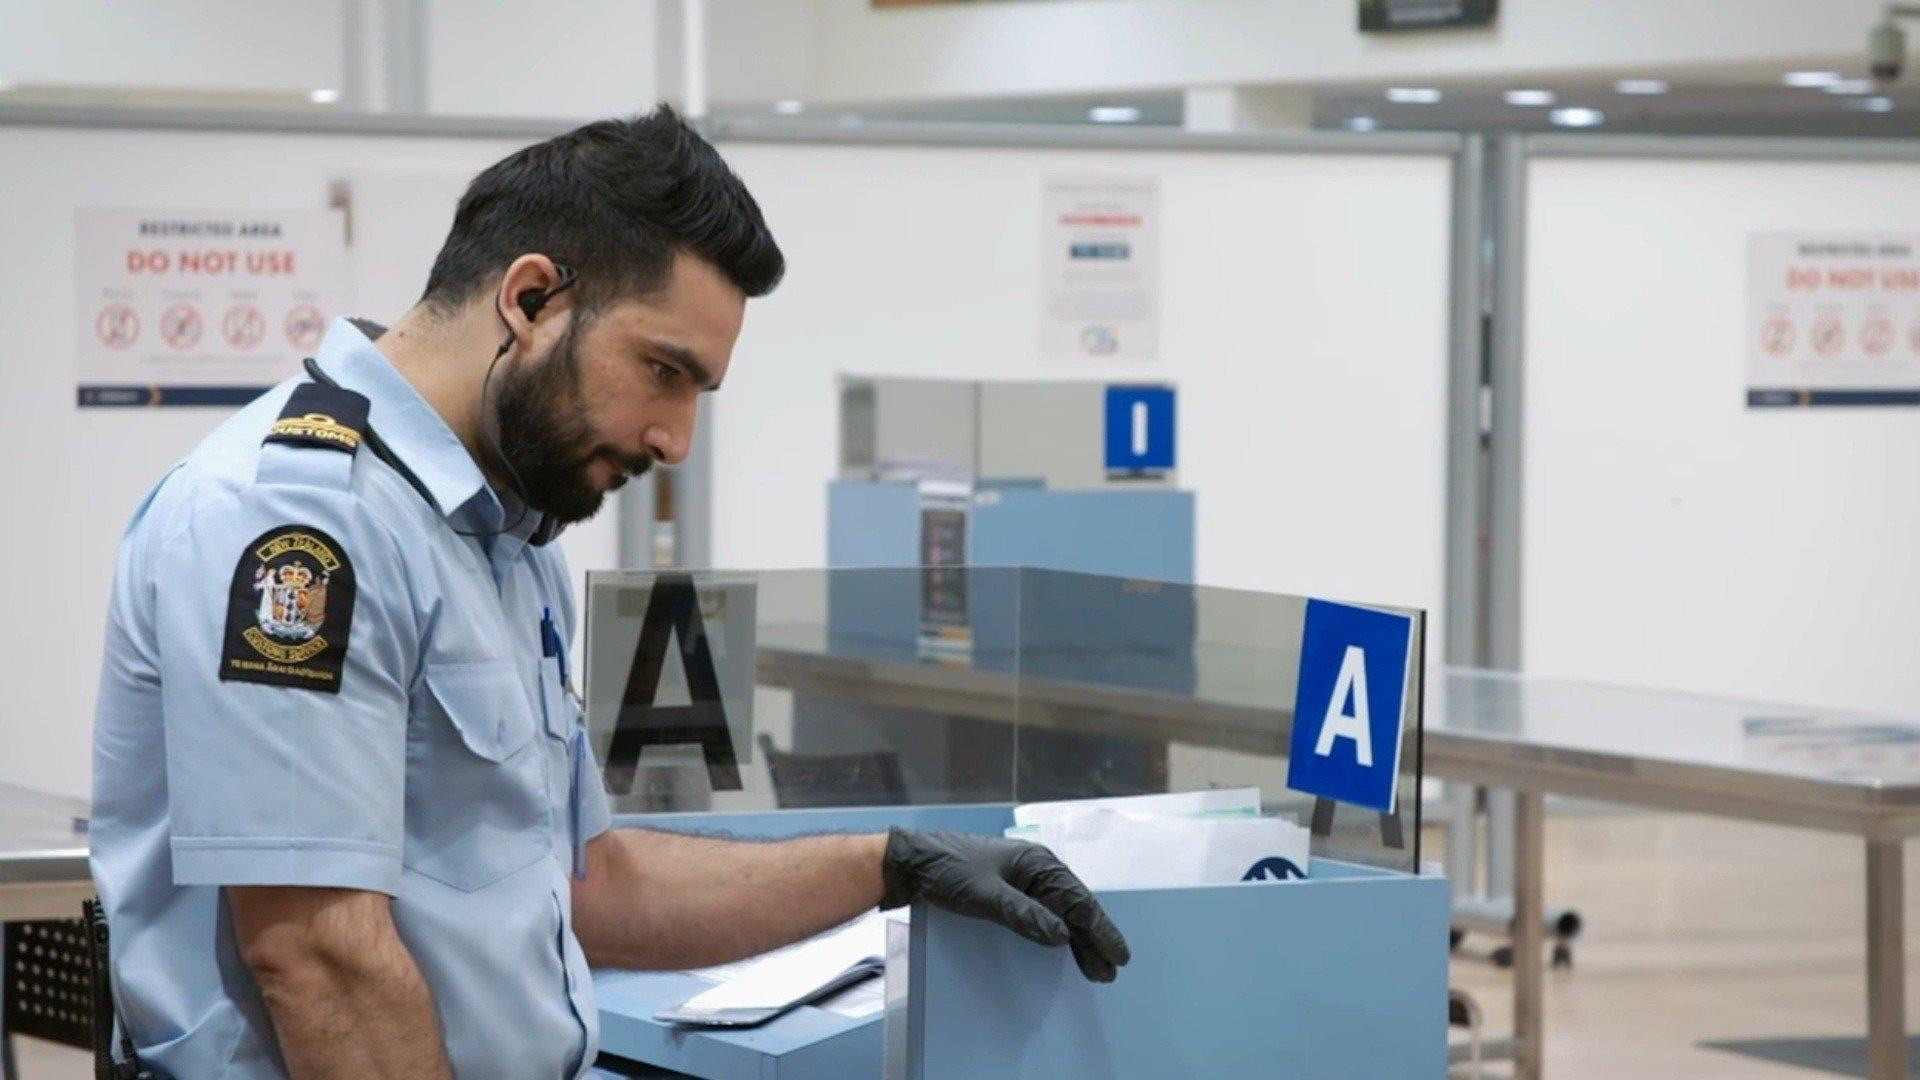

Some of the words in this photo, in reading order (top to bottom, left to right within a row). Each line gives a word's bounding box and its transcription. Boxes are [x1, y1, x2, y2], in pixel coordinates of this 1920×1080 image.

[126, 250, 170, 274] DO
[178, 250, 236, 274] NOT
[246, 250, 295, 274] USE
[604, 574, 743, 795] A
[1314, 645, 1373, 767] A
